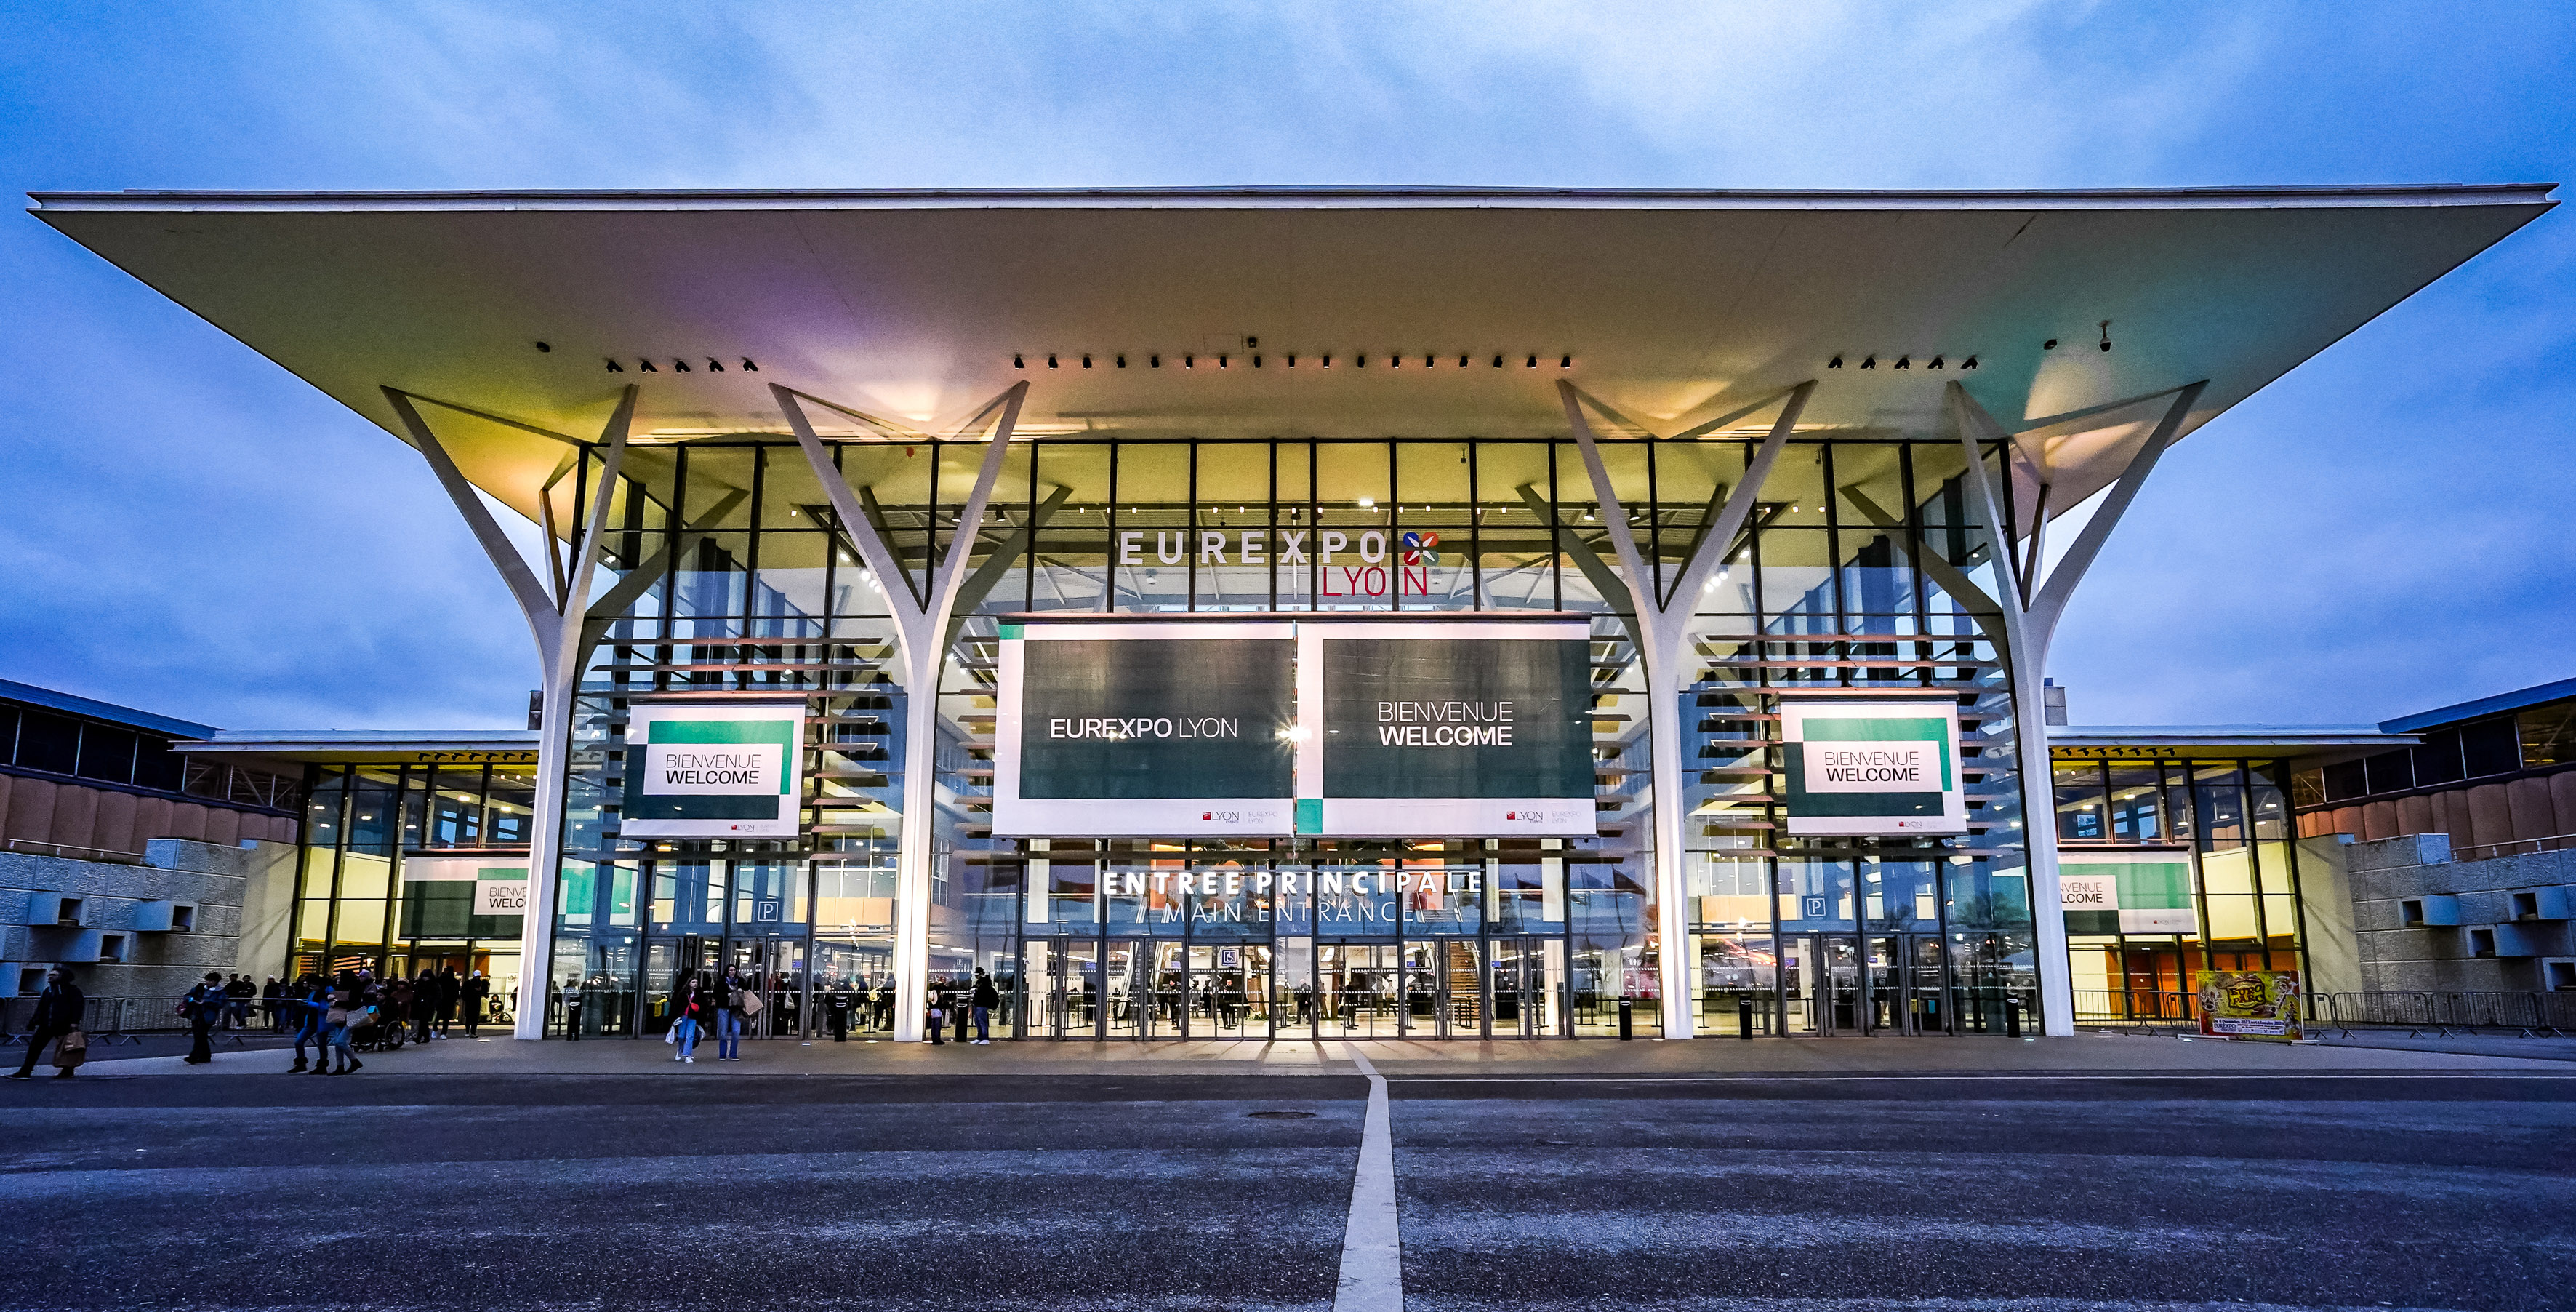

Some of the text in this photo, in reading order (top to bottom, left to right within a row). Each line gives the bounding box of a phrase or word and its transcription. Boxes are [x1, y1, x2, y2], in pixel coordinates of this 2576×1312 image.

[1120, 531, 1386, 564] EUREXPO
[1323, 567, 1427, 596] LYON
[1378, 702, 1513, 721] BIENVENUE
[1050, 718, 1237, 738] EUREXPO LYON
[1379, 726, 1512, 746] WELCOME
[666, 754, 761, 768] BIENVENUE
[1825, 751, 1919, 766] BIENVENUE
[666, 770, 759, 784] WELCOME
[1826, 768, 1919, 782] WELCOME
[1212, 811, 1239, 820] LYON
[1516, 811, 1543, 820] LYON
[1103, 871, 1481, 895] ENTREE PRINCIPALE
[489, 887, 527, 897] BIENVE
[2061, 893, 2103, 903] LCOME
[489, 898, 526, 908] WELC
[1163, 902, 1414, 922] MAIN ENTRANCE
[2229, 984, 2262, 996] EURO
[2233, 994, 2264, 1005] PARC
